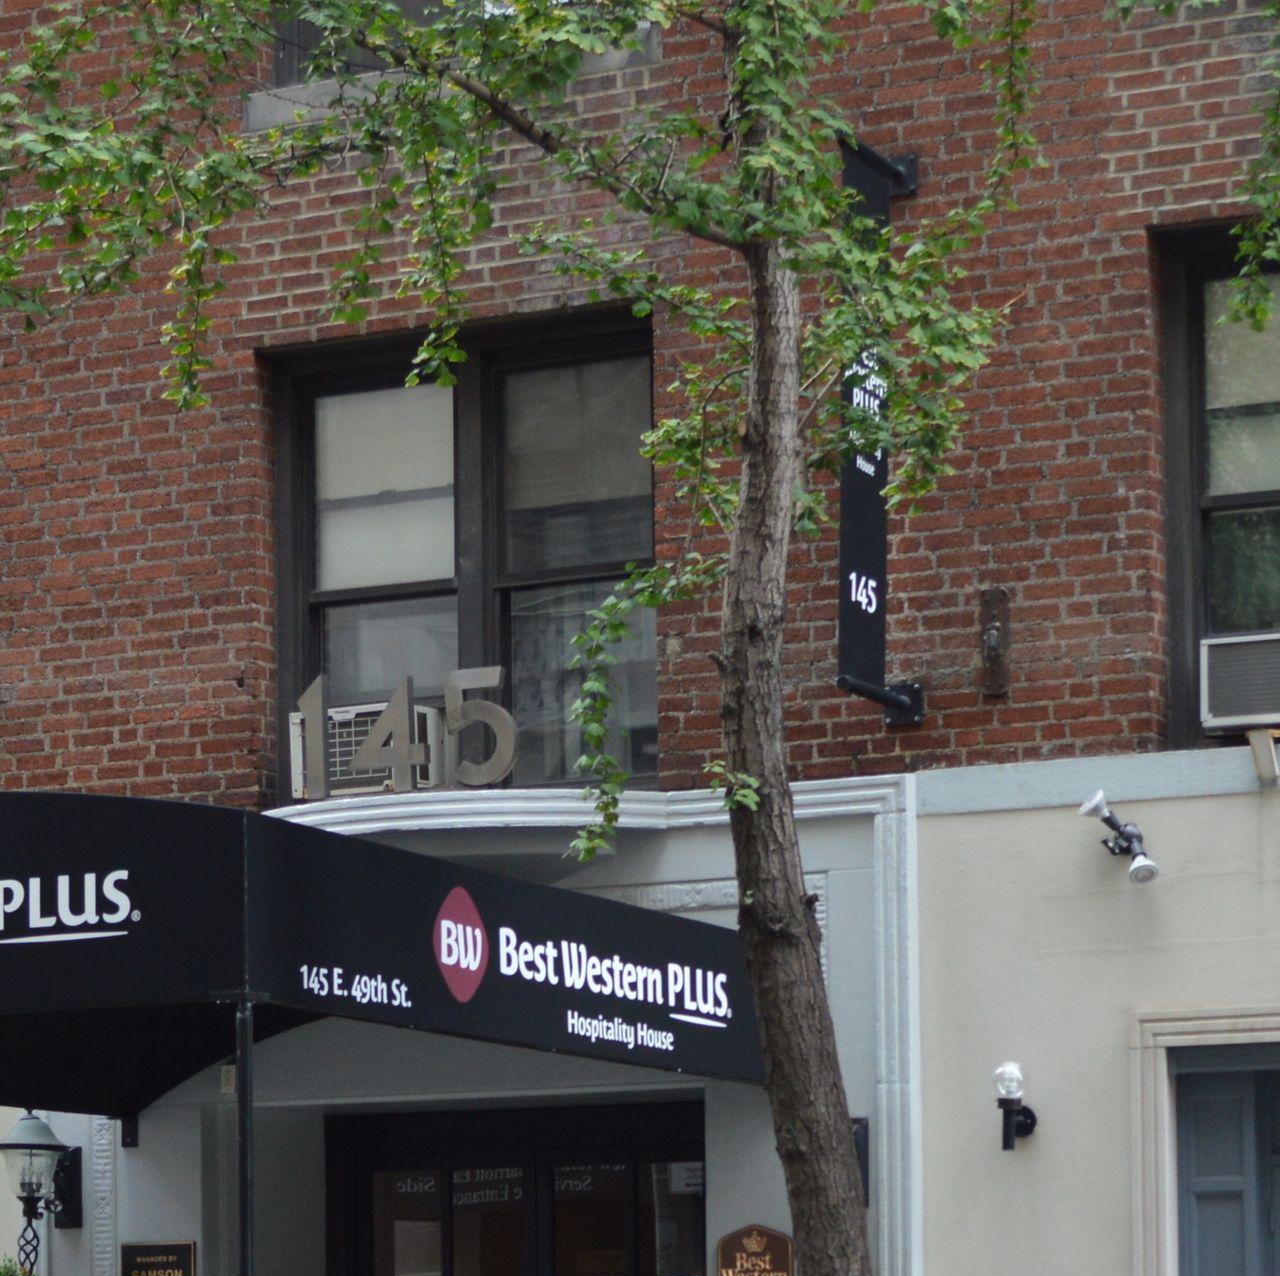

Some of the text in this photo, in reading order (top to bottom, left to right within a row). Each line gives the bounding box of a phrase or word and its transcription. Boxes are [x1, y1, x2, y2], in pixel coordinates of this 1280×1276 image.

[849, 571, 877, 614] 145
[297, 665, 518, 800] 145
[440, 919, 483, 972] BW
[499, 926, 559, 985] Best
[561, 940, 664, 1005] Western
[300, 964, 412, 1008] 145 E. 49th St.
[567, 1009, 675, 1051] Hospitality House
[736, 1252, 773, 1271] Best
